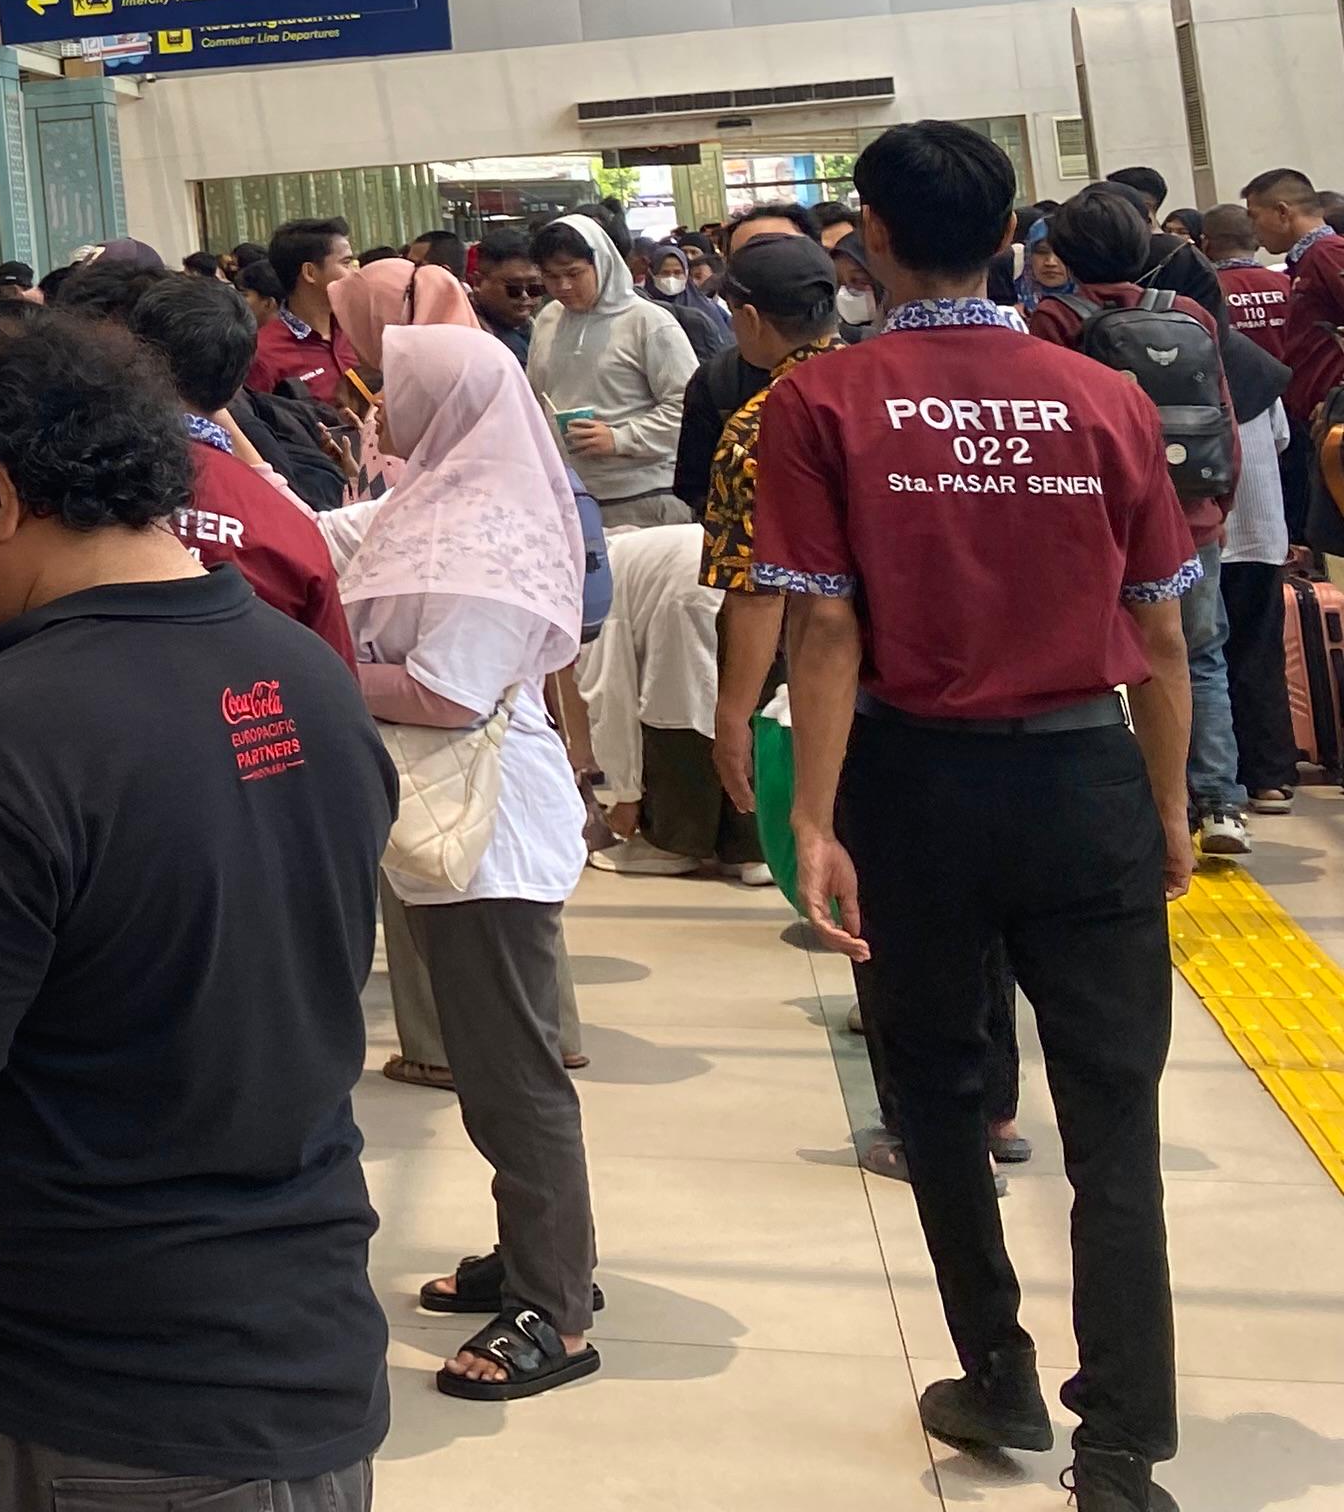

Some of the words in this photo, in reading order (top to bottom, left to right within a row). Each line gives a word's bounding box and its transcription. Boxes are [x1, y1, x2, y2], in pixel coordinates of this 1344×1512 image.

[200, 34, 255, 49] Commuter
[257, 32, 280, 44] Line
[281, 27, 341, 43] Departures
[1226, 290, 1286, 307] ORTER
[884, 397, 1074, 433] PORTER
[952, 437, 1033, 467] 022
[887, 473, 933, 495] Sta.
[938, 473, 1016, 495] PASAR
[1027, 475, 1104, 496] SENEN
[231, 718, 297, 748] EUROPACIFIC
[236, 738, 301, 770] PARTNERS
